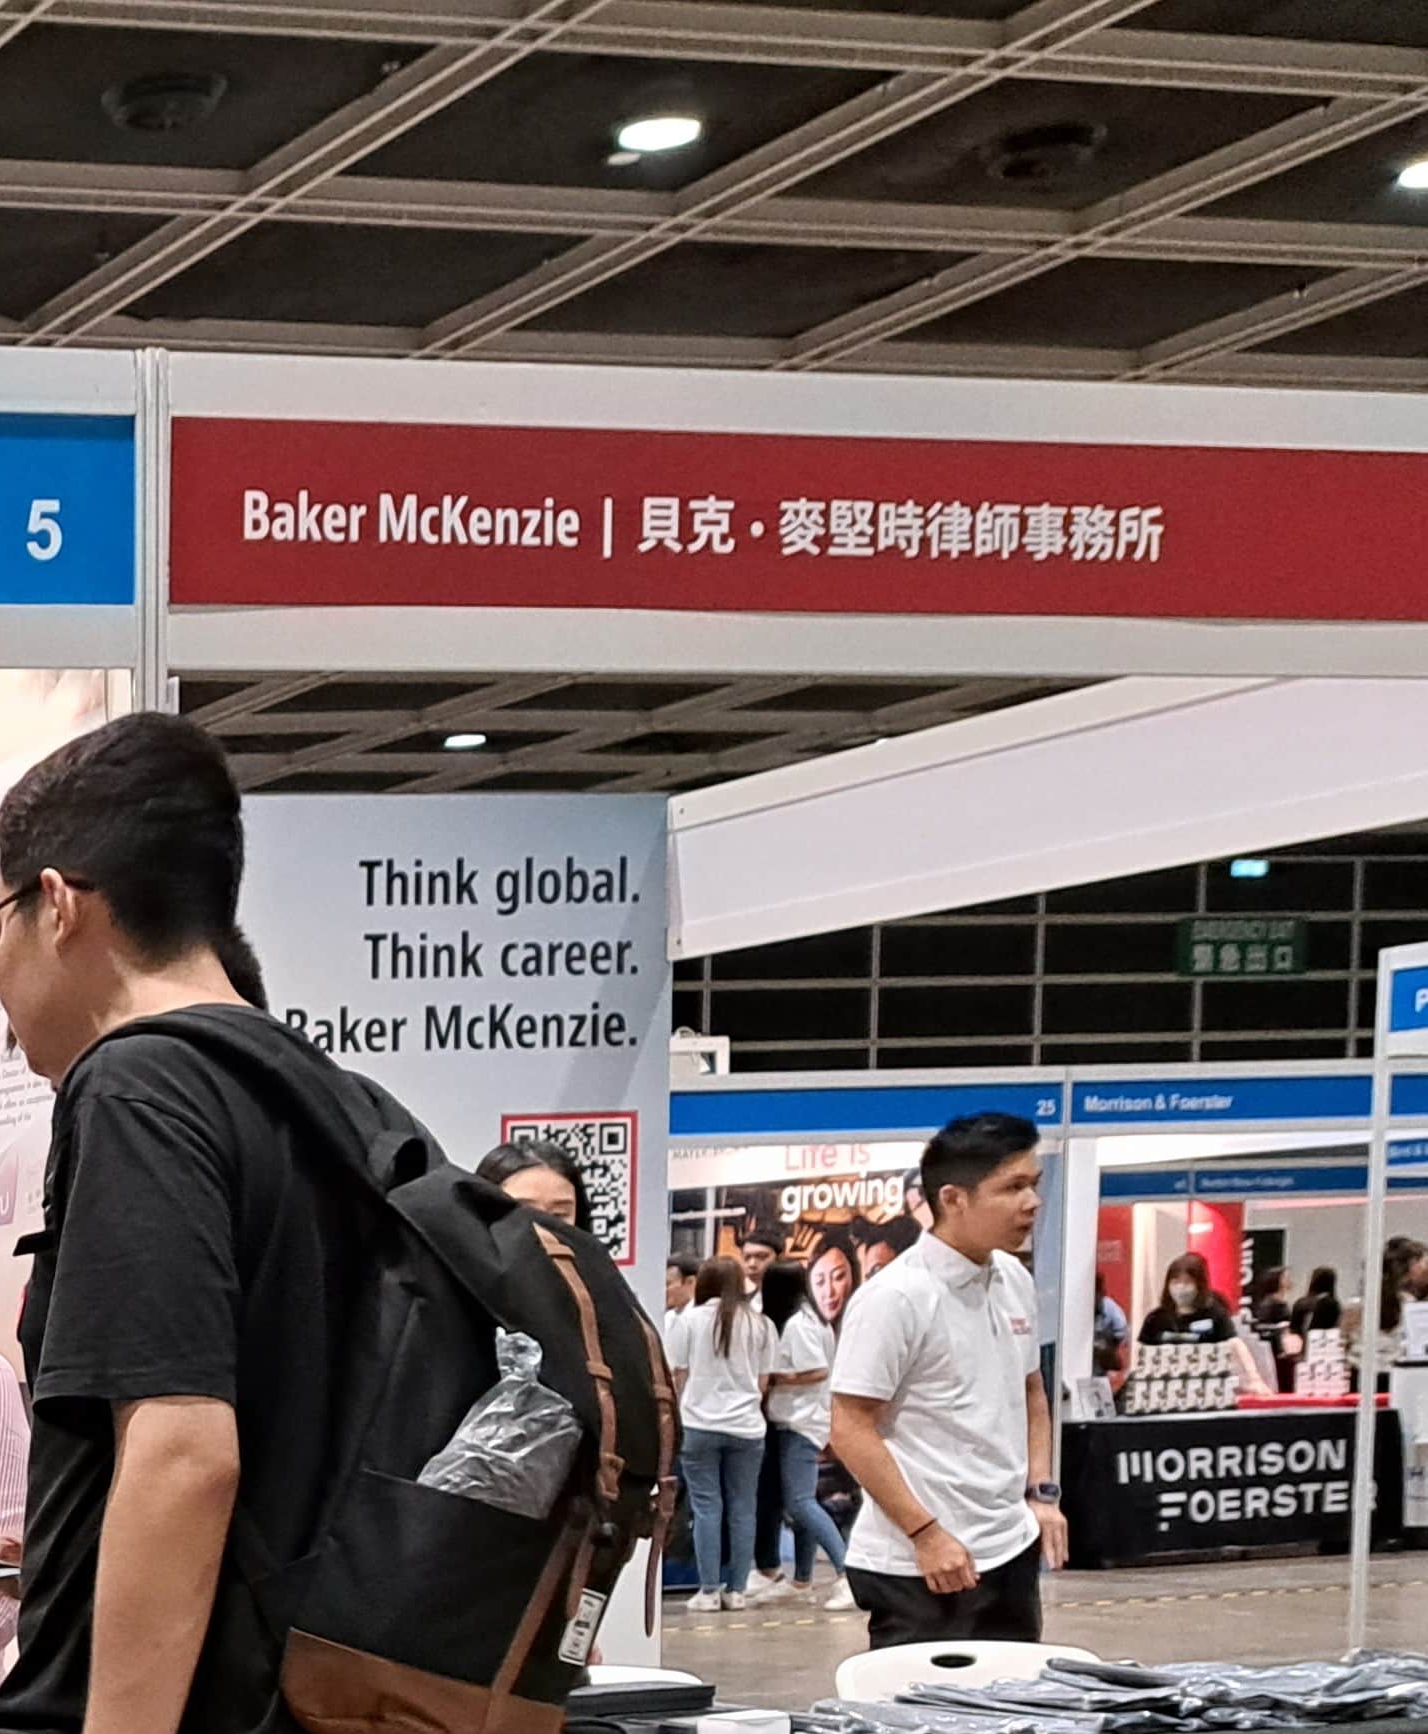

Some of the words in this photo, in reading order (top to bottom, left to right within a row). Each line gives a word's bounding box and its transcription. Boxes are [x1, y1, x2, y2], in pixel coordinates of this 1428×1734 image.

[27, 500, 62, 560] 5
[244, 490, 366, 542] Baker
[380, 494, 579, 546] McKenzie
[359, 858, 477, 906] Think
[497, 856, 639, 915] global.
[364, 931, 482, 979] Think
[501, 941, 638, 976] career.
[426, 1002, 637, 1050] McKenzie.
[1036, 1100, 1055, 1116] 25
[785, 1144, 838, 1171] Life
[780, 1170, 904, 1223] growing
[1118, 1440, 1345, 1483] MORRISON
